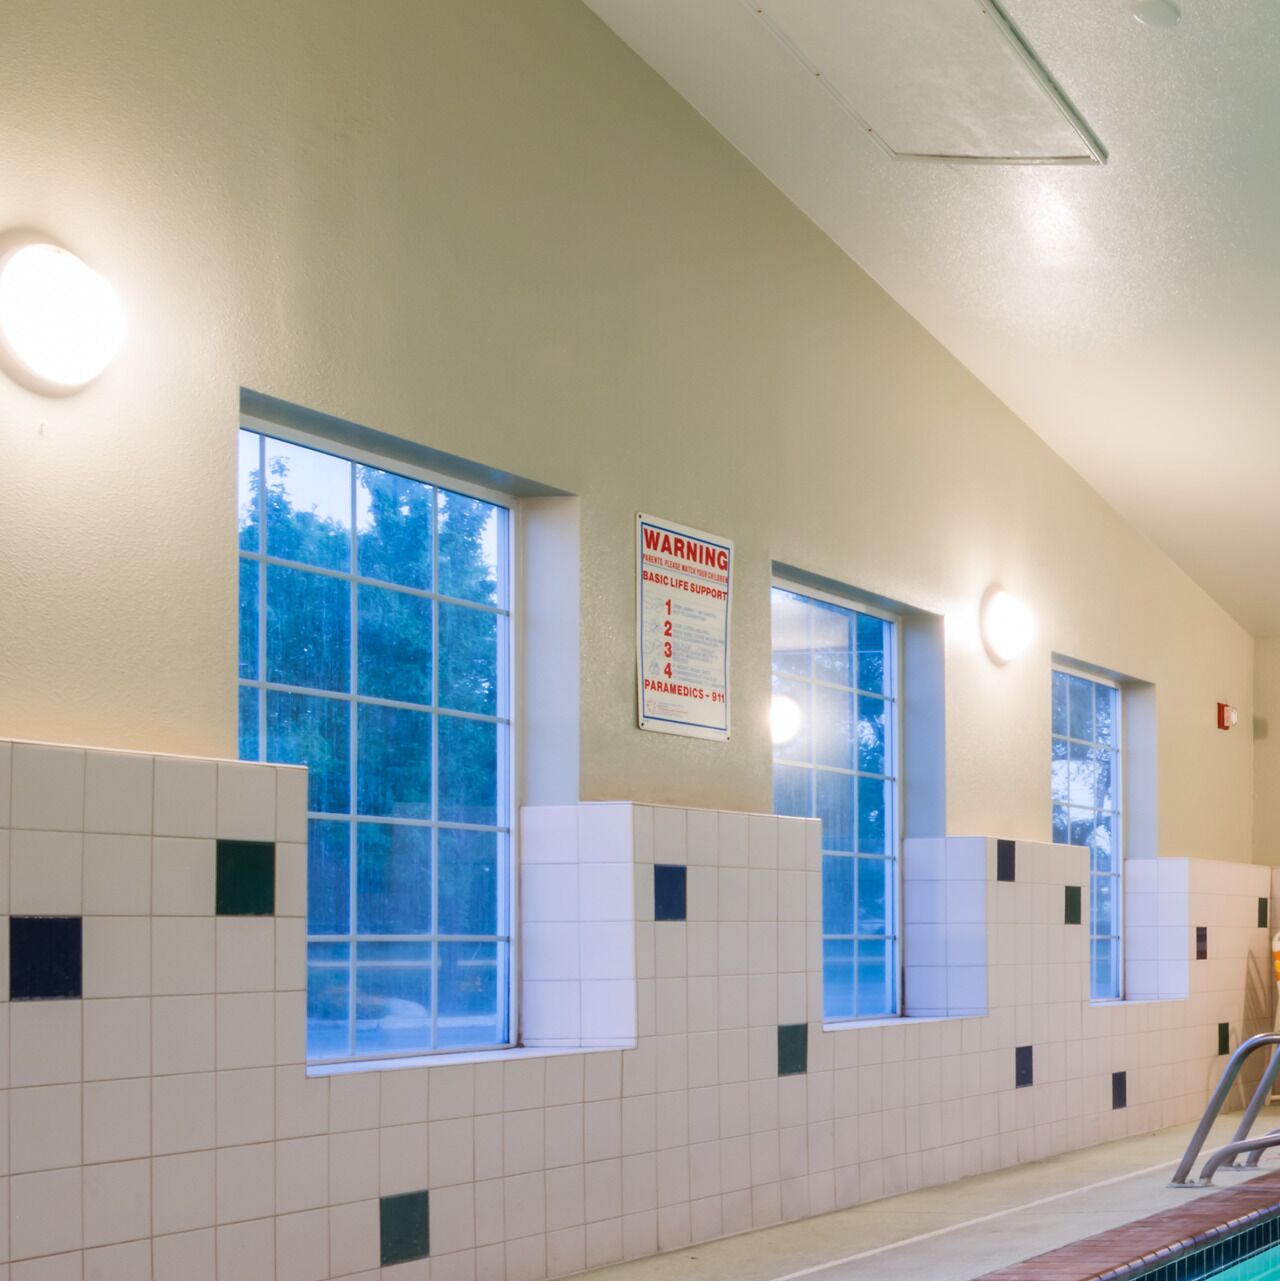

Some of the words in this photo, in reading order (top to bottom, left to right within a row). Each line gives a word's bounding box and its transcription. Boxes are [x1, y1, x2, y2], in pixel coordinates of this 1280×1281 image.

[643, 528, 728, 571] WARNING
[642, 570, 669, 586] BASIC
[670, 578, 689, 591] LIFE
[690, 583, 728, 600] SUPPORT
[665, 599, 672, 615] 1
[664, 620, 672, 637] 2
[664, 642, 672, 658] 3
[664, 663, 672, 678] 4
[644, 679, 704, 699] PARAMEDICS
[712, 692, 725, 703] 911
